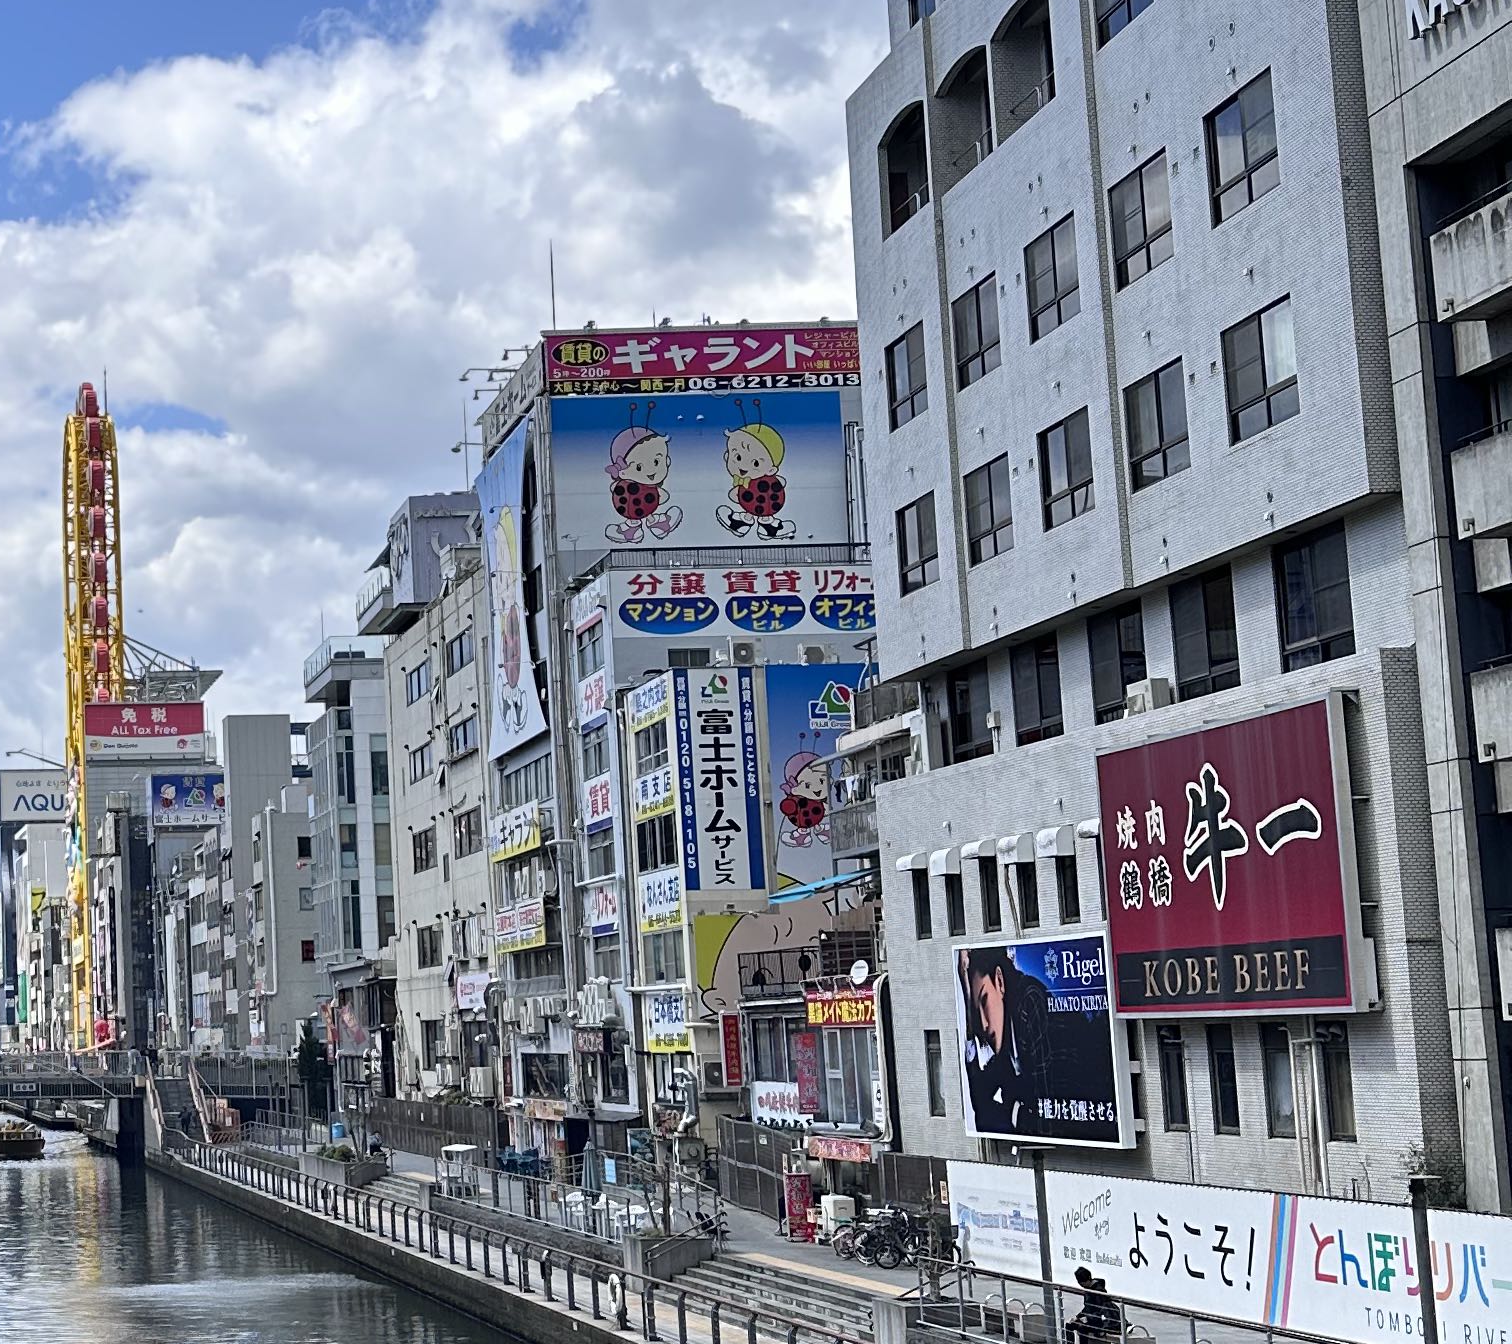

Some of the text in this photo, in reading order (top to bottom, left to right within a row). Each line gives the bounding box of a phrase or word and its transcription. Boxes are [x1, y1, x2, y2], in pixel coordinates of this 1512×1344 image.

[612, 333, 816, 374] ギャラント
[688, 373, 861, 391] 06-6212-3013
[628, 570, 875, 595] 分譲 賃貸 リフォー
[626, 601, 715, 622] マンション
[732, 600, 803, 620] レジャー
[753, 617, 870, 631] ビル ビル
[111, 724, 178, 736] ALL Tax Free
[121, 706, 168, 724] 免税
[13, 793, 68, 812] AQU
[696, 709, 742, 885] 富士ホームサービス
[1115, 799, 1167, 850] 焼肉
[1183, 762, 1322, 911] 牛一
[1119, 855, 1173, 910] 鶴橋
[1061, 947, 1105, 985] Rigel
[1143, 949, 1310, 997] KOBE BEEF
[1047, 994, 1109, 1013] HAYATO KIRIYA
[1061, 1187, 1112, 1236] Welcome
[1364, 1306, 1447, 1341] TOMBOI
